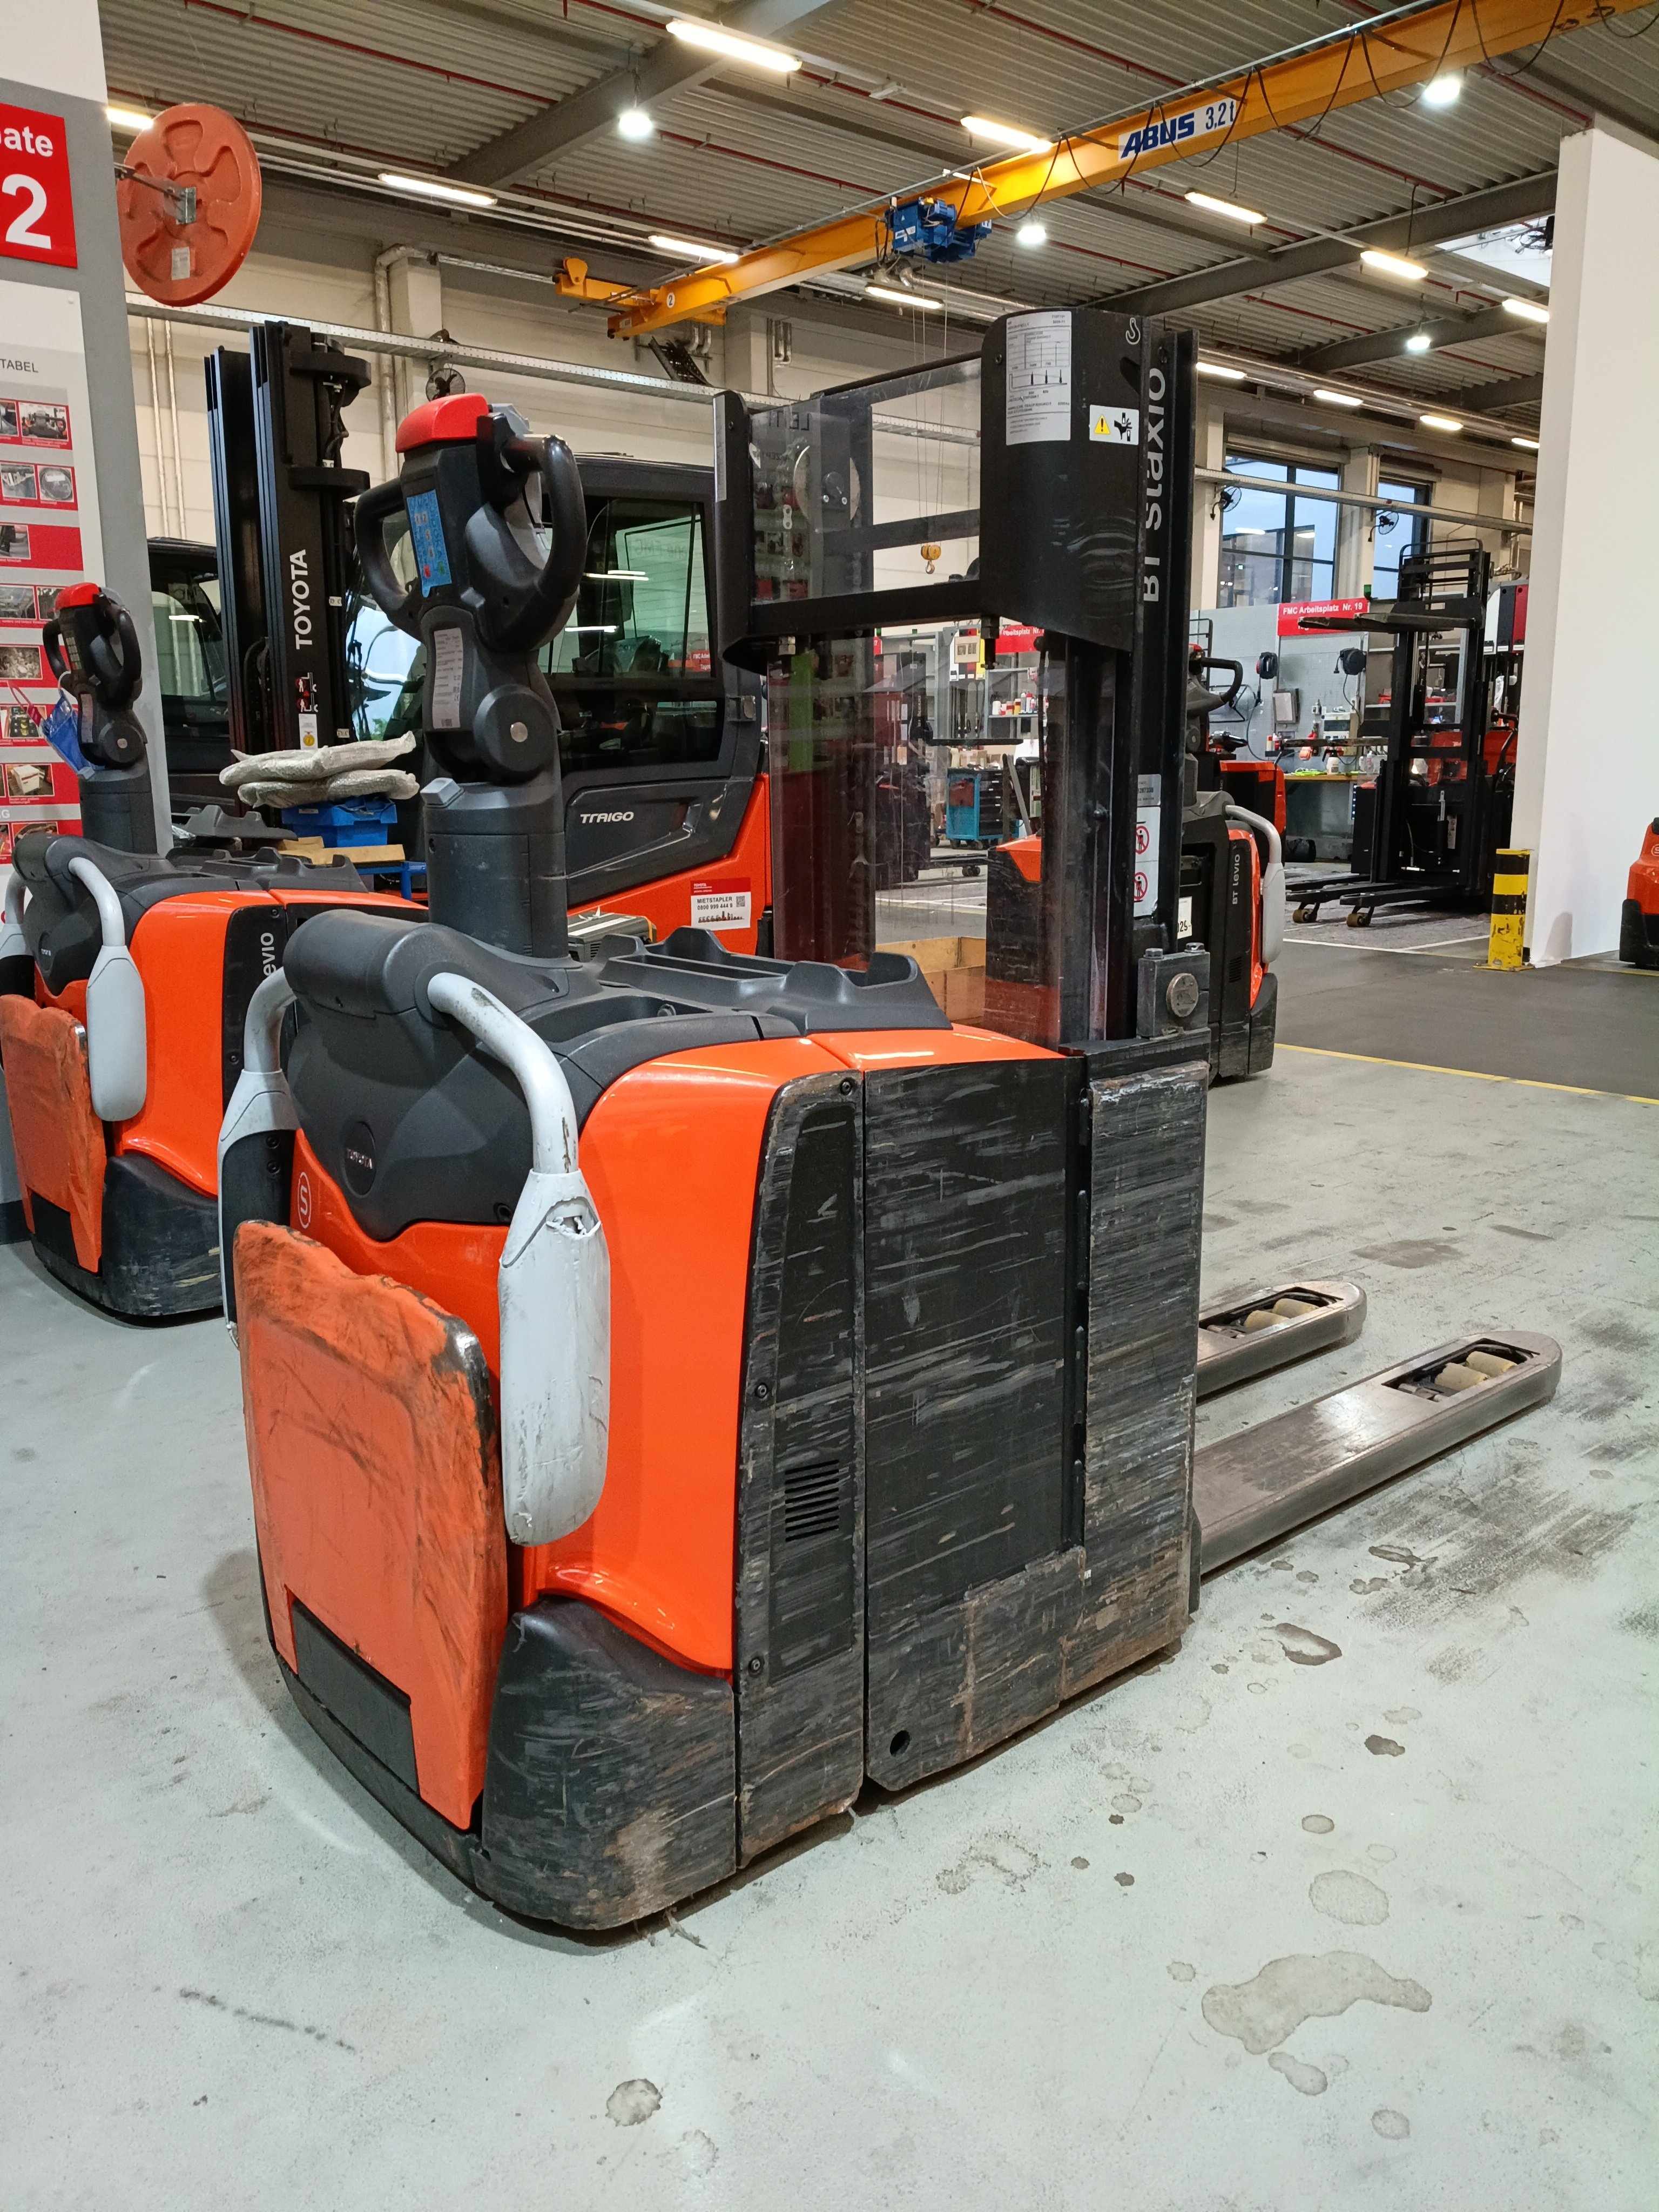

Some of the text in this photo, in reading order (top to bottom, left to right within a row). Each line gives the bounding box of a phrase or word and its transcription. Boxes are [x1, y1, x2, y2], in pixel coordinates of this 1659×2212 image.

[0, 126, 53, 157] ate
[1121, 112, 1194, 159] ABUS
[1205, 102, 1226, 130] 3,2
[2, 173, 51, 249] 2
[669, 295, 673, 306] 2
[290, 549, 312, 650] TOYOTA
[1283, 606, 1298, 615] FMC
[1299, 604, 1339, 614] Arbeitsplatz
[1232, 891, 1238, 905] BT
[260, 932, 276, 976] evio
[346, 1148, 372, 1169] TOYOTA
